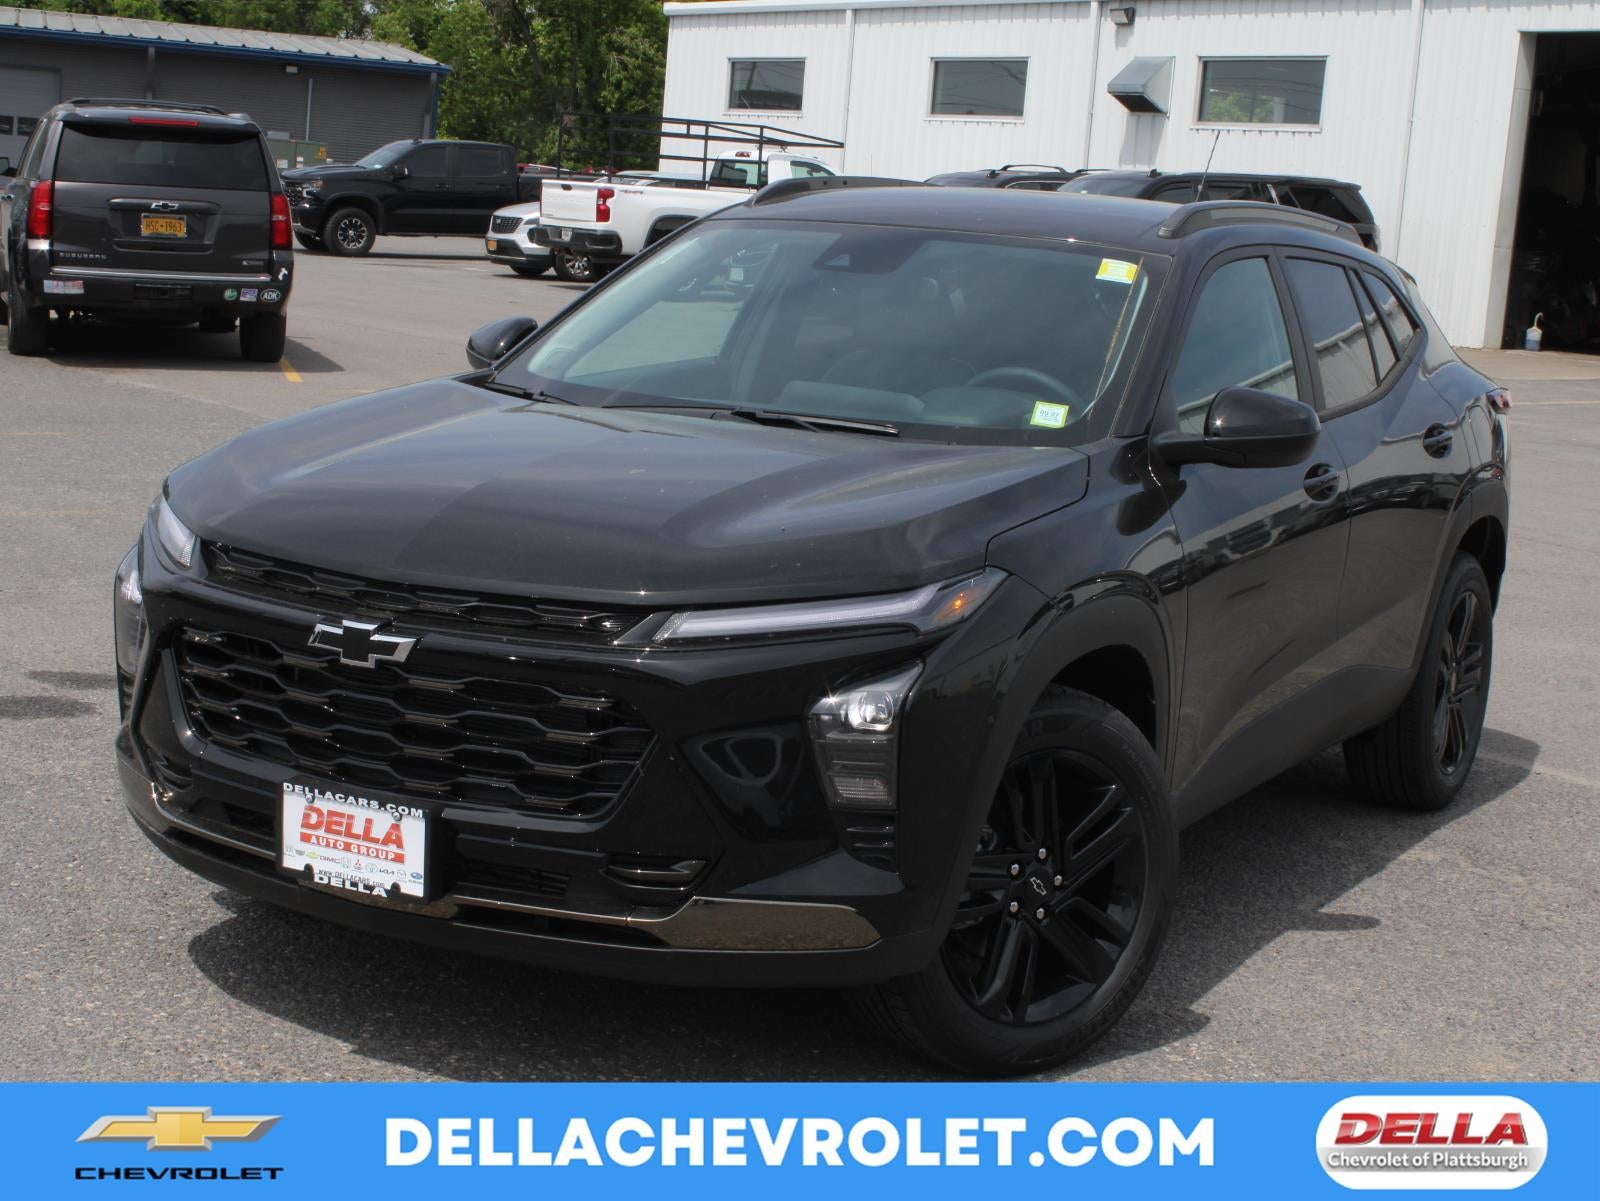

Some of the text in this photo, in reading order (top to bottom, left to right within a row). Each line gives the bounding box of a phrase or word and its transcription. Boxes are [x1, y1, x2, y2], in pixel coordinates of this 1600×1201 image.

[262, 292, 278, 300] ADK
[283, 782, 423, 818] DELLACARS.COM
[300, 805, 404, 849] DELLA
[310, 835, 395, 860] AUTO GROUP
